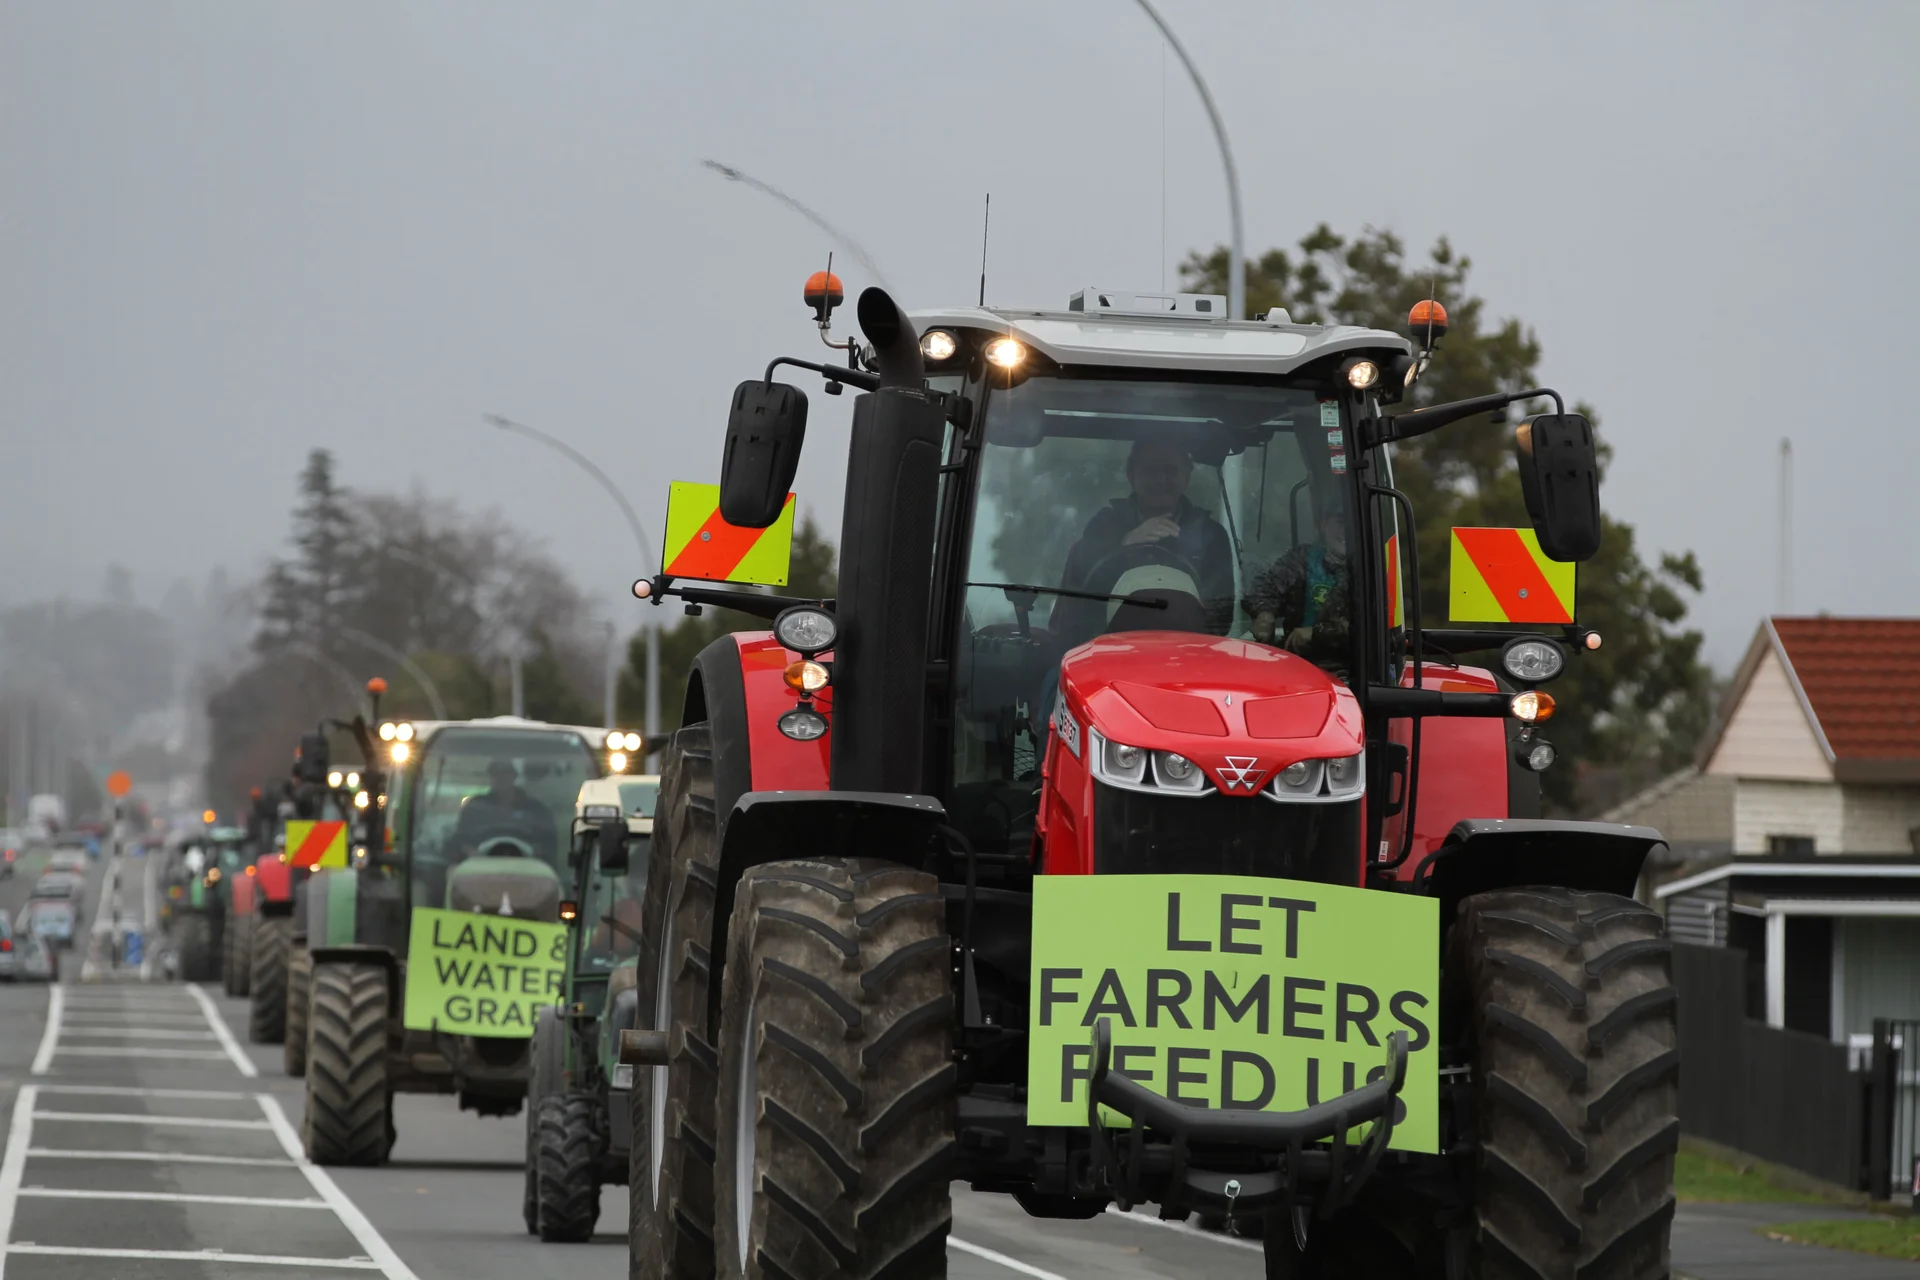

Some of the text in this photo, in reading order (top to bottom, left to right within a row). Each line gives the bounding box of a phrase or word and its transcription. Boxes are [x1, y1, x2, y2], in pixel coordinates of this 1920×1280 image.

[432, 918, 567, 961] LAND &
[1166, 892, 1317, 959] LET
[434, 956, 565, 995] WATER
[1039, 968, 1431, 1053] FARMERS
[1060, 1044, 1277, 1112] FEED
